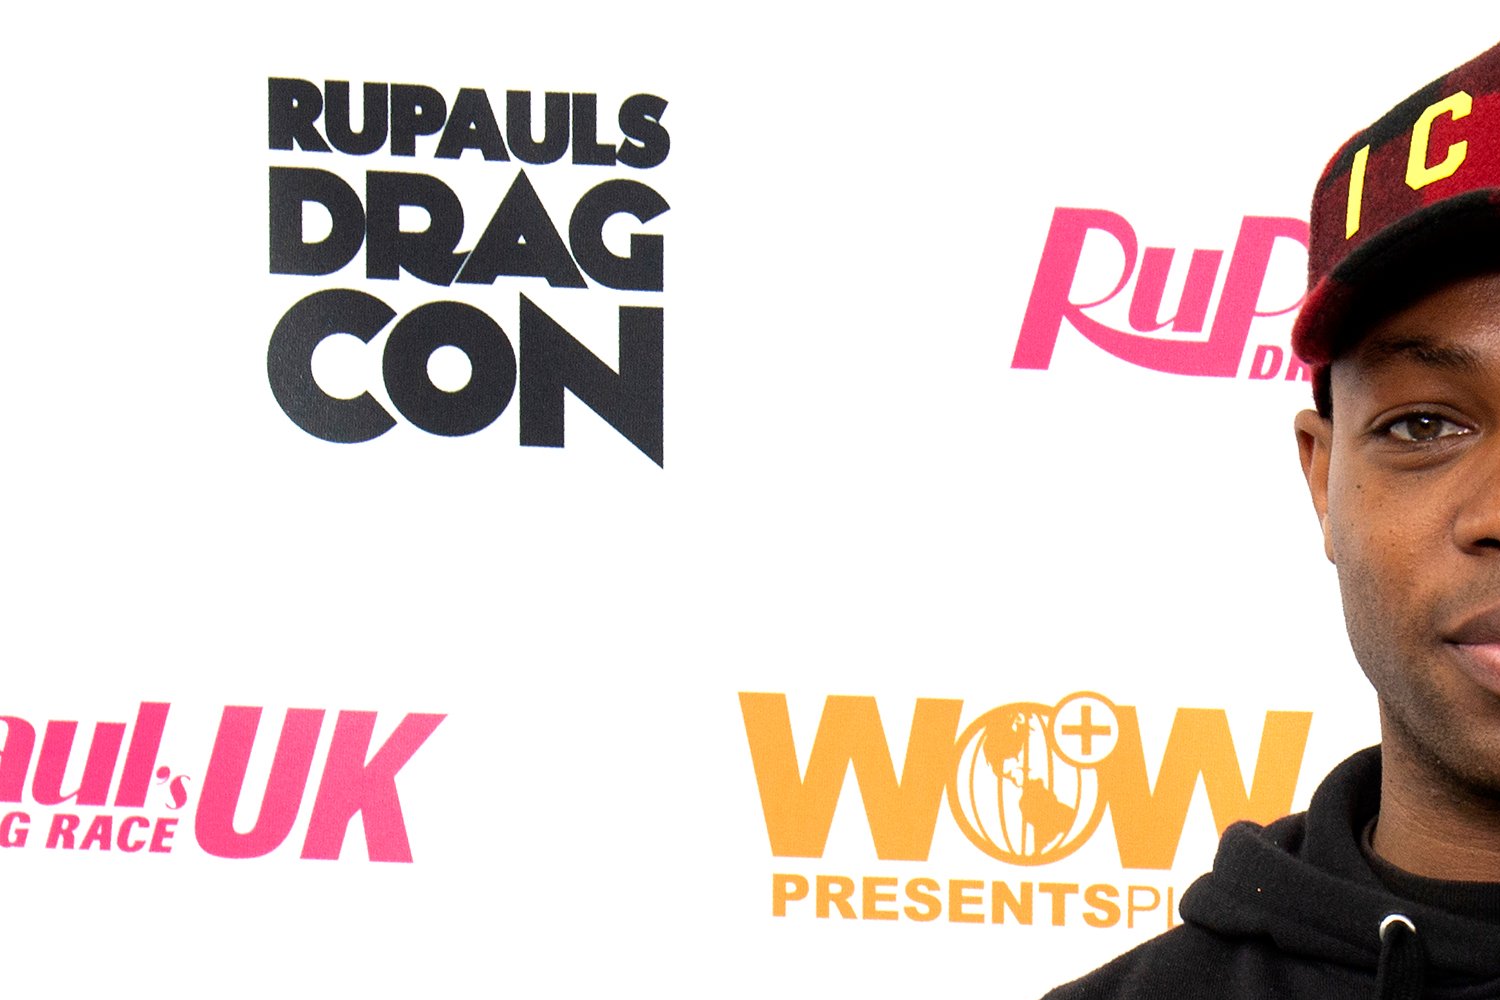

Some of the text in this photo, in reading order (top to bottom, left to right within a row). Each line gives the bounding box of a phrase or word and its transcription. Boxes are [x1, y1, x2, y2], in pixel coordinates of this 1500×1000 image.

[267, 76, 671, 170] RUPAULS
[268, 166, 671, 293] DRAG
[266, 288, 664, 470] CON
[45, 813, 180, 854] RACE
[194, 703, 449, 864] UK
